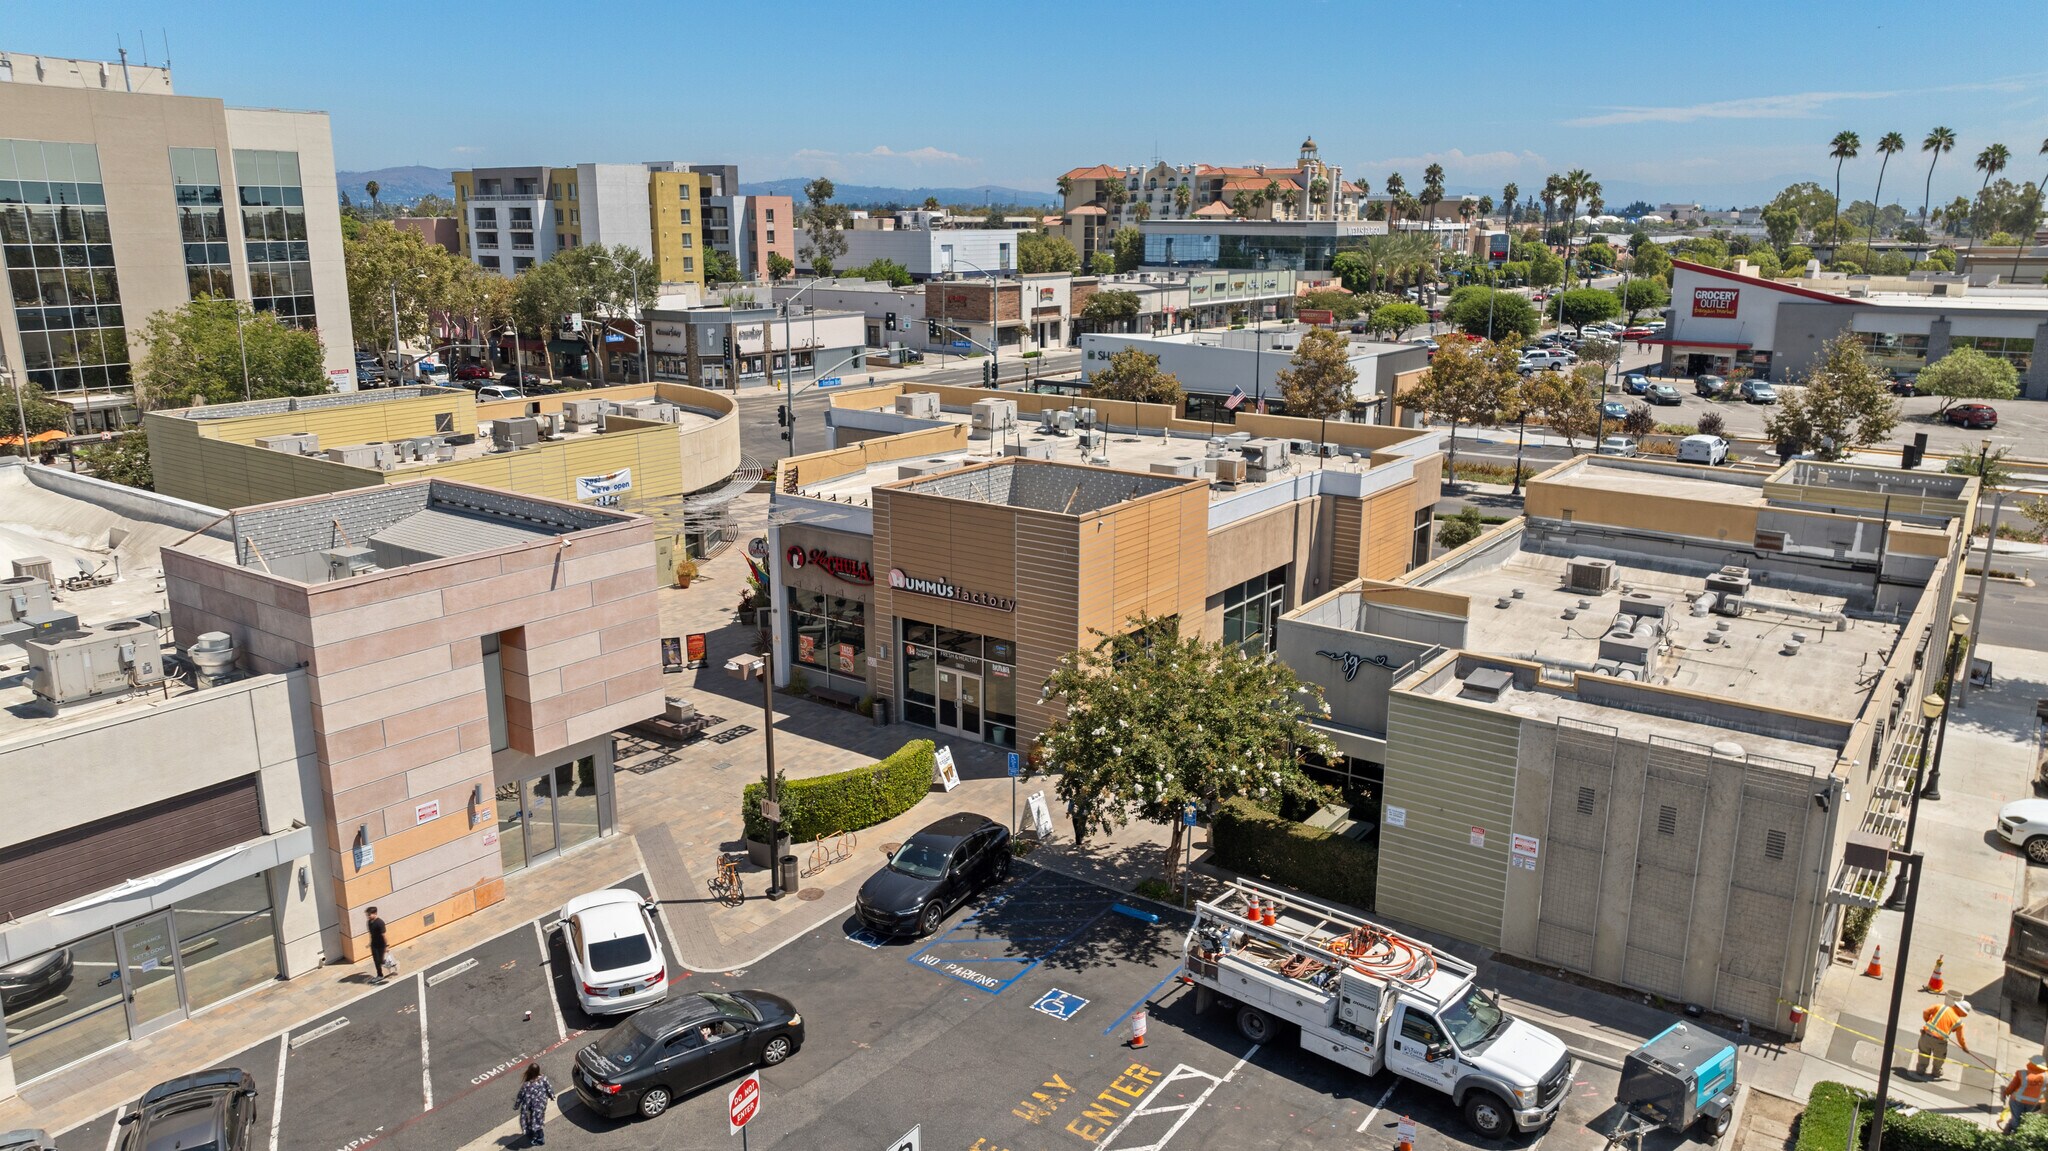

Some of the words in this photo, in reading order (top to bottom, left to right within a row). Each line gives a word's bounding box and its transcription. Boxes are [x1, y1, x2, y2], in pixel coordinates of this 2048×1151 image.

[1695, 290, 1738, 301] GROCERY
[1700, 299, 1731, 309] OUTLET
[591, 486, 610, 494] we're
[614, 482, 630, 491] open
[827, 556, 871, 581] CHULA
[889, 569, 954, 598] HUMMUS
[955, 587, 1015, 612] factory
[940, 651, 954, 659] FRESH
[959, 654, 978, 664] HEALTHY
[132, 934, 161, 949] ENTRANCE
[919, 954, 941, 966] NO
[945, 963, 999, 988] PARKING
[1352, 1000, 1376, 1012] DOOSAN
[470, 1052, 529, 1086] COMPACT
[733, 1094, 743, 1106] DO
[744, 1081, 756, 1097] NOT
[1012, 1073, 1077, 1125] WAY
[1065, 1063, 1162, 1143] ENTER
[737, 1102, 755, 1122] ENTER
